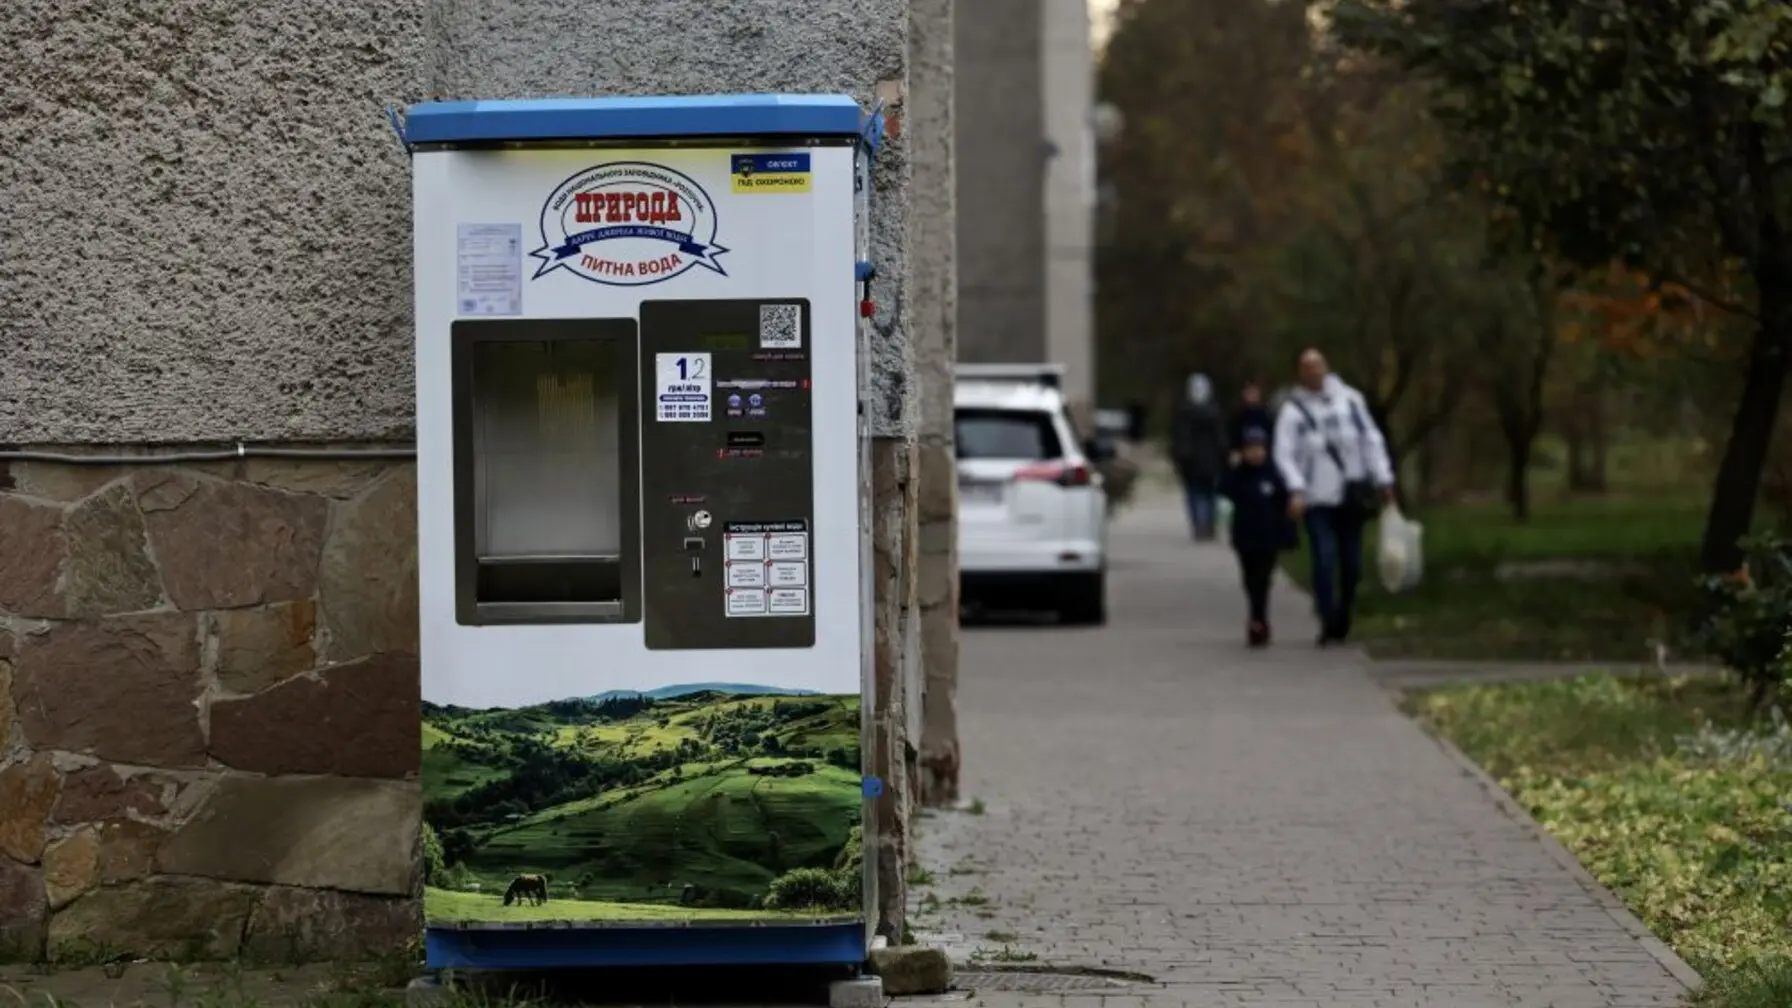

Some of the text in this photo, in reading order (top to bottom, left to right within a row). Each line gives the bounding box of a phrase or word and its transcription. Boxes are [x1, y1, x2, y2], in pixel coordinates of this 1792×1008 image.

[575, 191, 682, 225] ПРИРОДА
[580, 253, 683, 276] ПИТНА ВОДА
